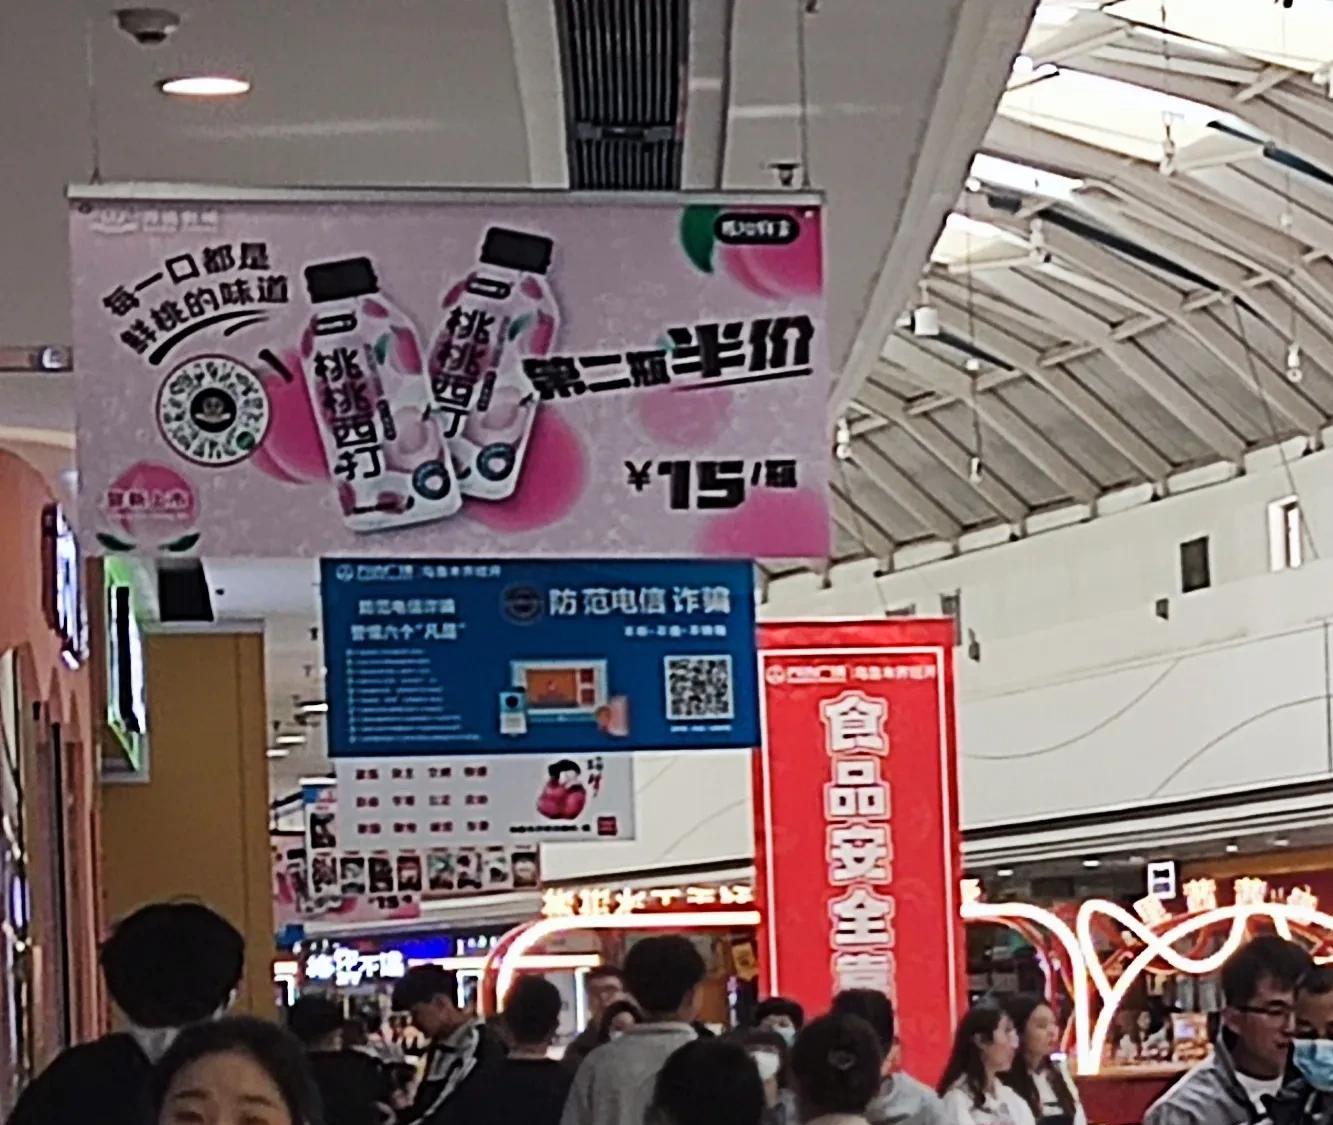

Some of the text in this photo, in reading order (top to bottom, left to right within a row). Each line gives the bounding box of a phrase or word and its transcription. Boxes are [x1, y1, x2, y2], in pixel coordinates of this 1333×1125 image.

[103, 242, 269, 316] 每一口都是
[120, 275, 288, 354] 鲜桃的味道
[549, 586, 731, 616] 防范电信诈骗
